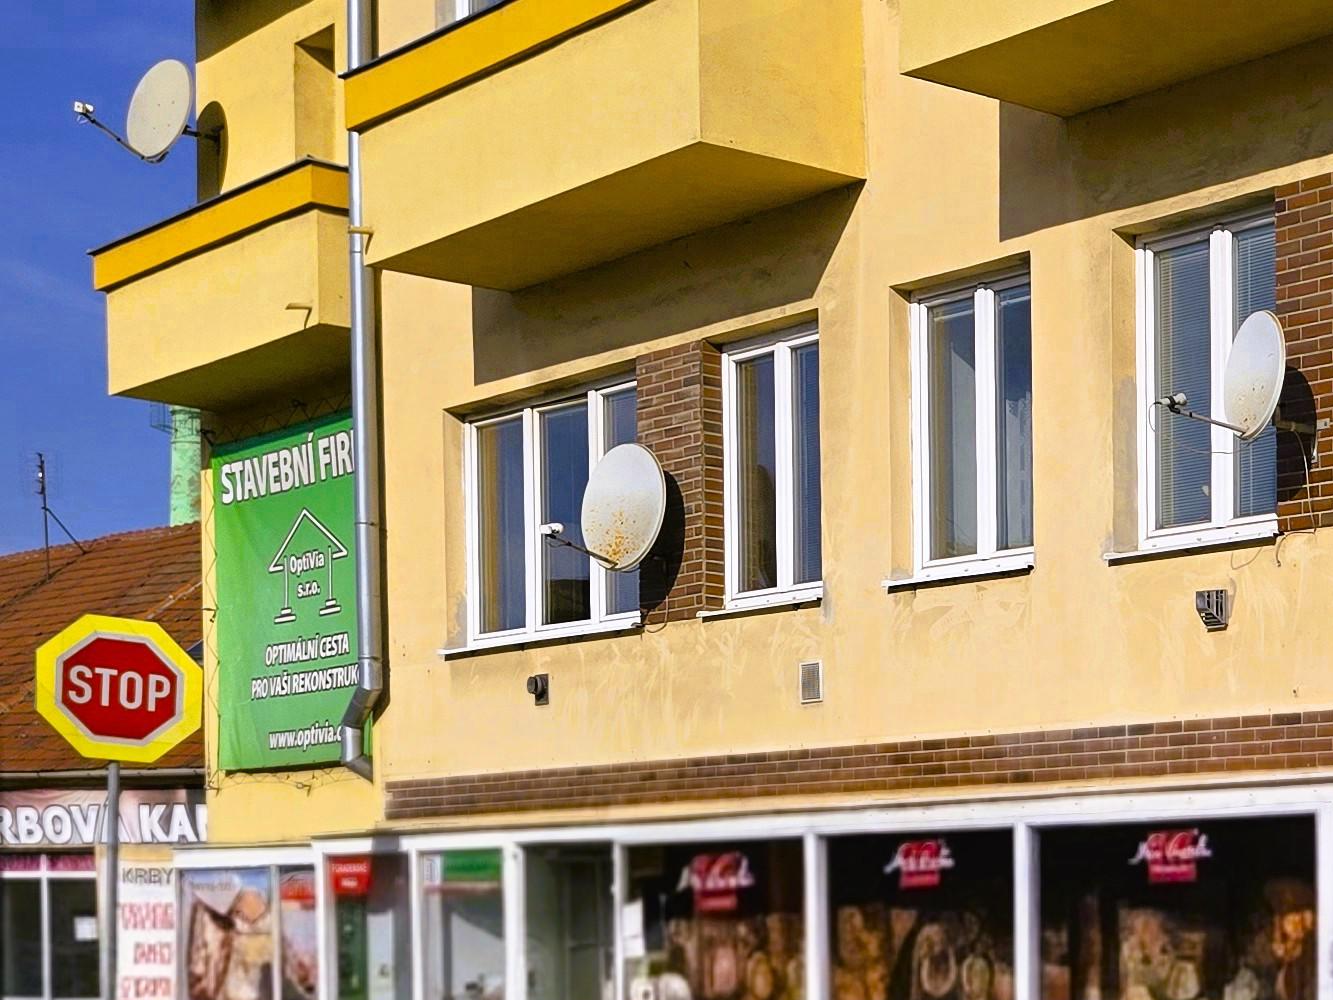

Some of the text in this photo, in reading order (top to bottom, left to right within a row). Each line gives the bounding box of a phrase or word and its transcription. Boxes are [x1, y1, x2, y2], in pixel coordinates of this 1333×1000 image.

[221, 432, 316, 505] STAVEBNÍ
[290, 550, 325, 576] OptiVia
[297, 581, 321, 599] s.r.o.
[265, 633, 349, 666] OPTIMÁLNÍ CESTA
[68, 664, 171, 712] STOP
[251, 678, 268, 700] PRO
[269, 671, 291, 696] VAŠI
[122, 868, 174, 885] KRBY
